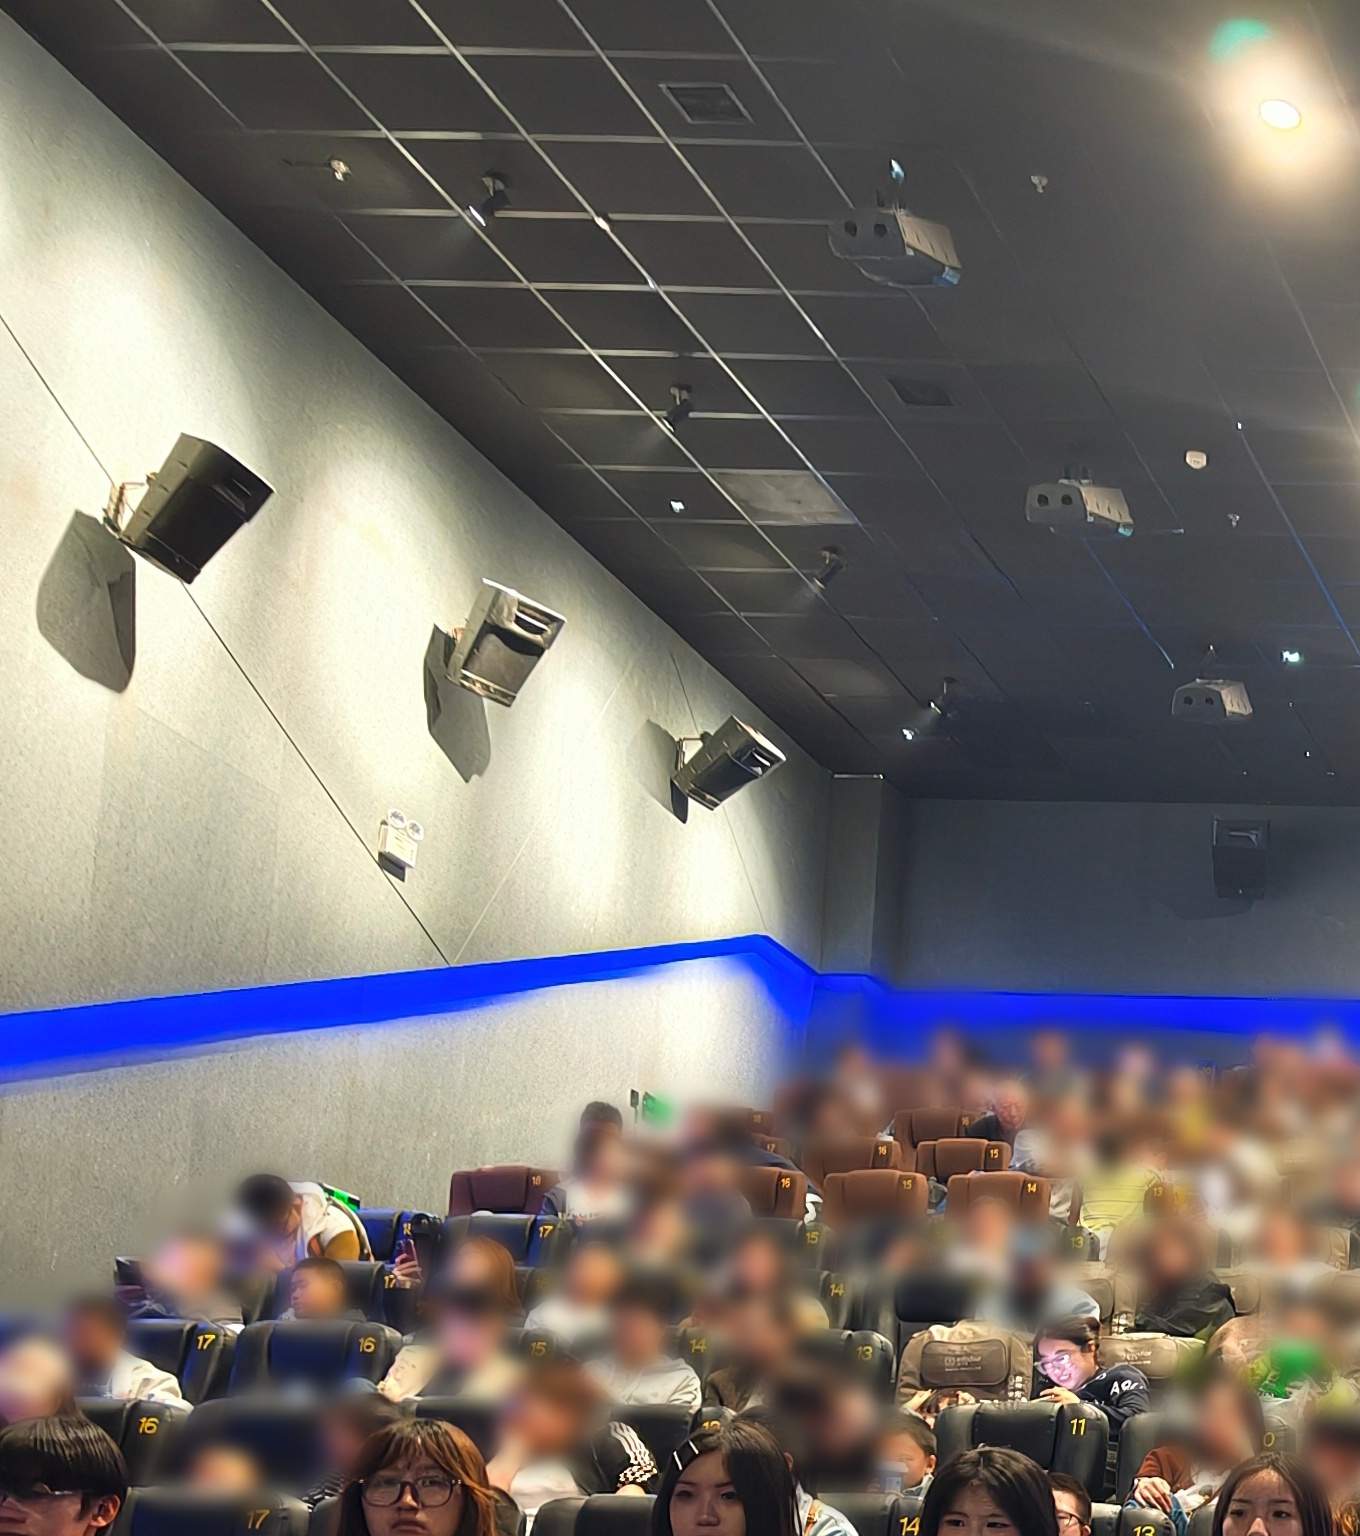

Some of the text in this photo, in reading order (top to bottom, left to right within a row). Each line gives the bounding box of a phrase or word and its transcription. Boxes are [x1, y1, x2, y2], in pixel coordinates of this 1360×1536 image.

[990, 1149, 999, 1159] 15
[1027, 1183, 1037, 1194] 14
[538, 1225, 553, 1238] 17
[805, 1231, 819, 1244] 15
[384, 1274, 397, 1288] 17
[830, 1284, 844, 1297] 14
[196, 1334, 216, 1350] 17
[359, 1336, 377, 1353] 16
[530, 1342, 547, 1355] 15
[689, 1338, 707, 1353] 14
[856, 1346, 873, 1360] 13
[138, 1417, 159, 1434] 16
[1070, 1418, 1086, 1436] 11
[247, 1509, 270, 1529] 17
[900, 1517, 920, 1536] 14
